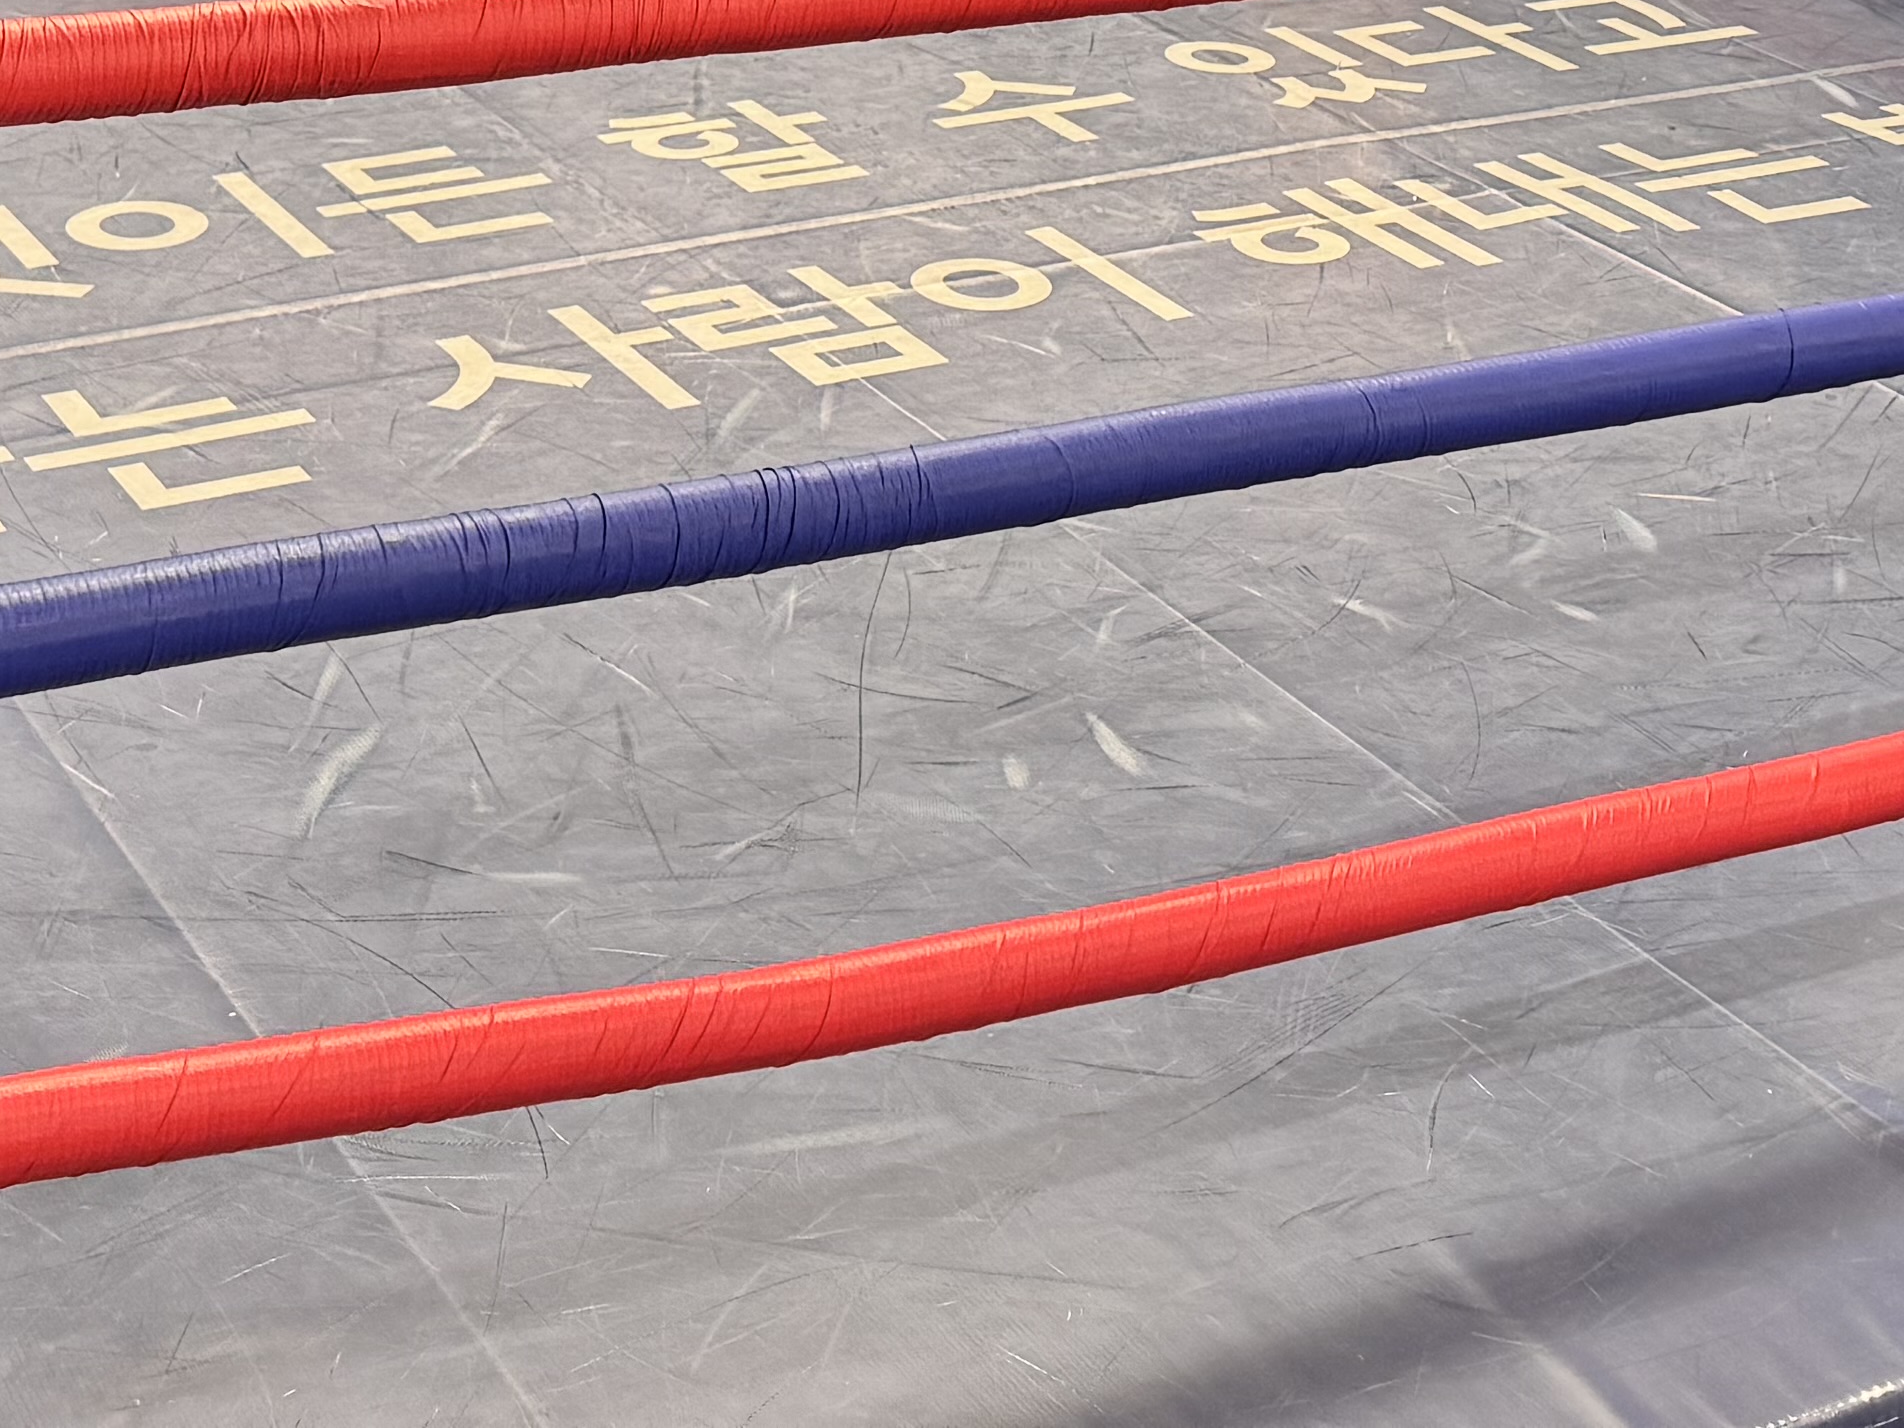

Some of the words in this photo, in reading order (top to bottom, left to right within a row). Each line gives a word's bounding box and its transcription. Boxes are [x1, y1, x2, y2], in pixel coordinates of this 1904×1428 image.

[596, 98, 869, 194] 할
[932, 69, 1135, 143] 수
[427, 225, 1195, 411] 사람이
[1191, 142, 1872, 270] 해내는
